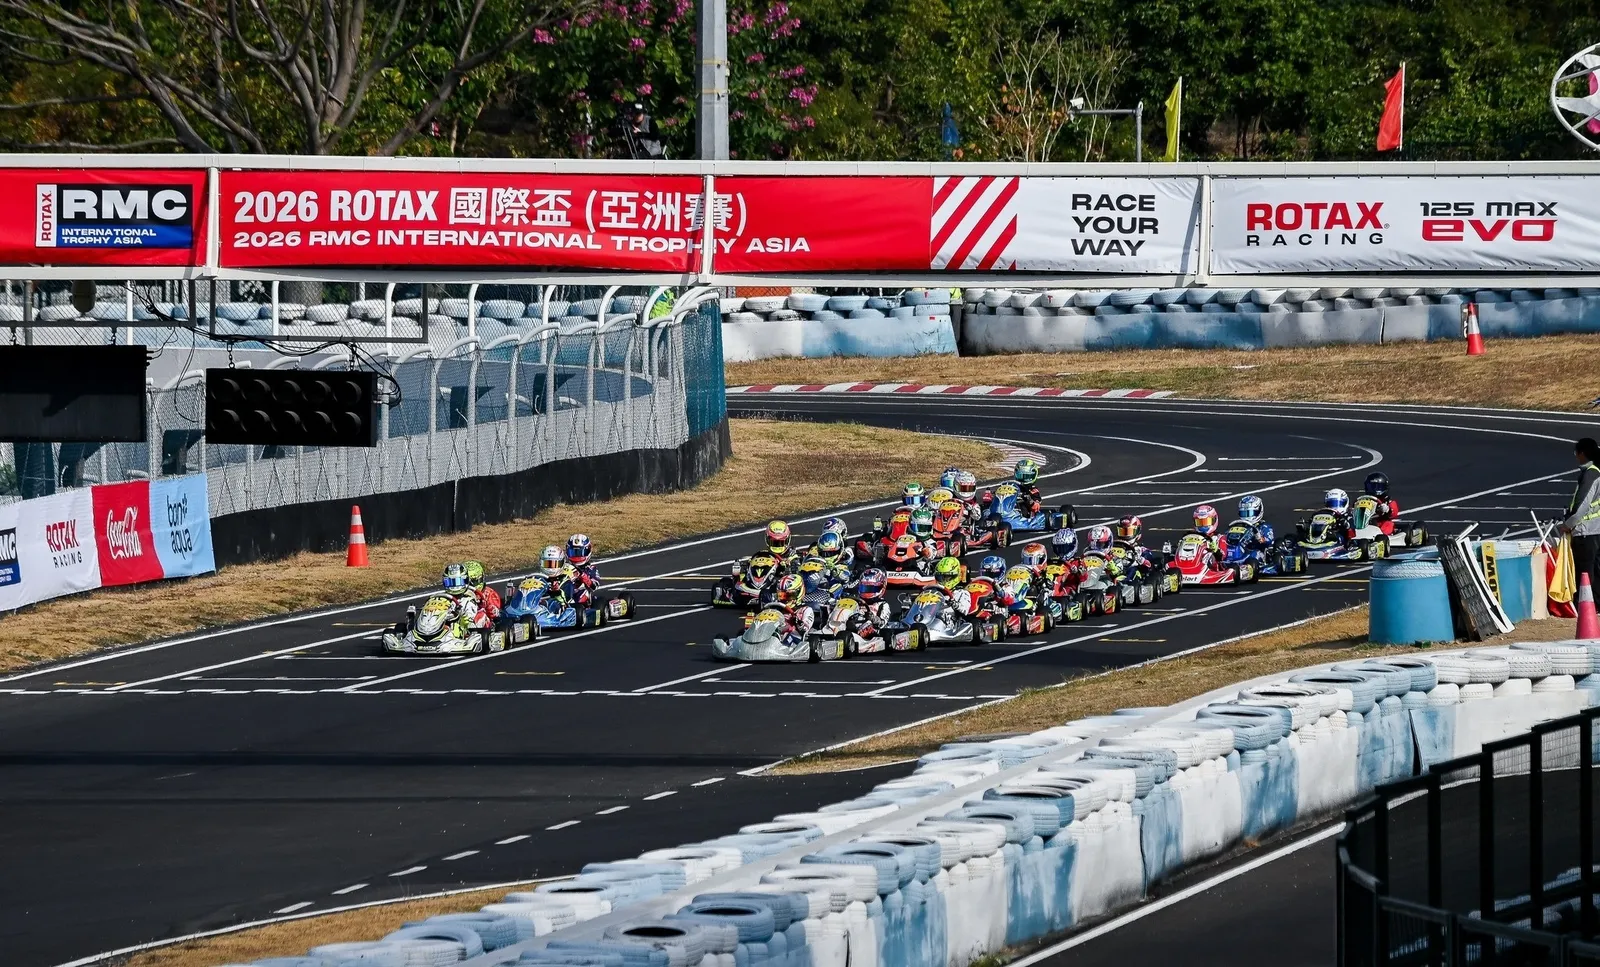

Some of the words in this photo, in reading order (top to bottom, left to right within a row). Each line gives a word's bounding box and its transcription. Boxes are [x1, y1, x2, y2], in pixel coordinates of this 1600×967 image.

[62, 189, 188, 221] RMC
[234, 191, 318, 223] 2026
[330, 190, 437, 222] ROTAX
[448, 187, 572, 227] 國際盃
[1071, 194, 1156, 212] RACE
[1420, 202, 1474, 216] 125
[1486, 202, 1558, 216] MAX
[41, 190, 52, 243] ROTAX
[1072, 215, 1159, 235] YOUR
[61, 228, 157, 237] INTERNATIONAL
[62, 237, 110, 245] TROPHY
[113, 236, 143, 245] ASIA
[233, 231, 301, 248] 2026
[308, 230, 370, 247] RMC
[377, 230, 602, 249] INTERNATIONAL
[615, 235, 737, 254] TROPHY
[747, 237, 811, 253] ASIA
[1246, 233, 1384, 247] RACING
[1071, 239, 1146, 257] WAY
[0, 533, 16, 561] MC
[46, 519, 79, 553] ROTAX
[170, 528, 193, 561] aqua
[53, 551, 82, 568] RACING
[1486, 554, 1499, 602] OW
